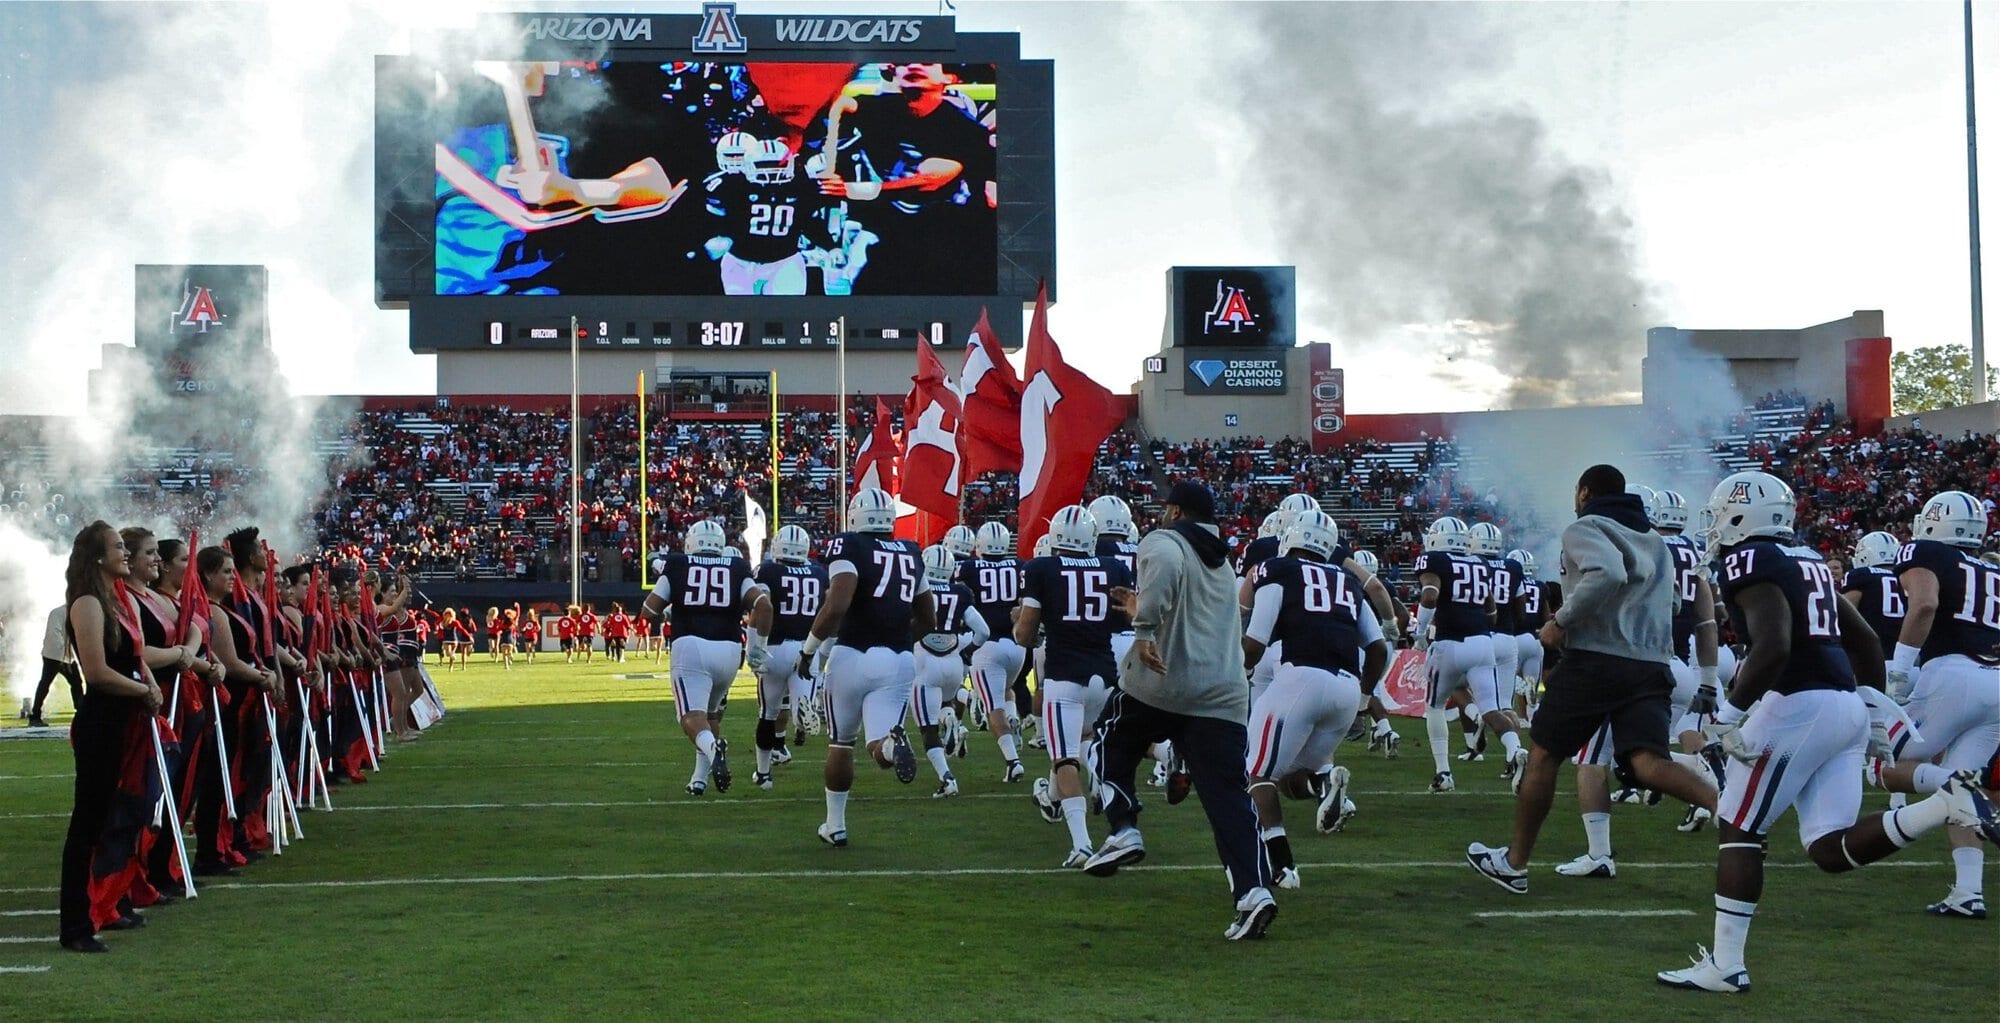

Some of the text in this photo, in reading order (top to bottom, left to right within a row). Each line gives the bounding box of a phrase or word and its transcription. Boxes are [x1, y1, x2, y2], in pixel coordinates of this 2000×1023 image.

[521, 18, 652, 40] ARIZONA
[692, 2, 747, 53] A
[776, 19, 922, 42] WILDCATS
[749, 204, 794, 236] 20
[491, 322, 502, 344] 0
[531, 329, 557, 338] ARIZONA
[701, 322, 744, 346] 3:07
[803, 322, 809, 336] 1
[882, 329, 899, 339] UTAH
[931, 322, 943, 345] 0
[1148, 358, 1162, 372] 00
[1224, 369, 1284, 378] DIAMOND
[1230, 360, 1278, 369] DESERT
[176, 380, 217, 391] zero
[1226, 378, 1282, 387] CASINOS
[717, 402, 727, 413] 12
[1226, 415, 1237, 425] 14
[1728, 482, 1752, 504] A
[1725, 549, 1755, 581] 27
[684, 566, 731, 607] 99
[873, 550, 916, 603] 75
[979, 567, 1017, 603] 90
[1451, 562, 1489, 605] 26
[780, 576, 820, 616] 38
[1061, 570, 1108, 622] 15
[1301, 564, 1357, 621] 84
